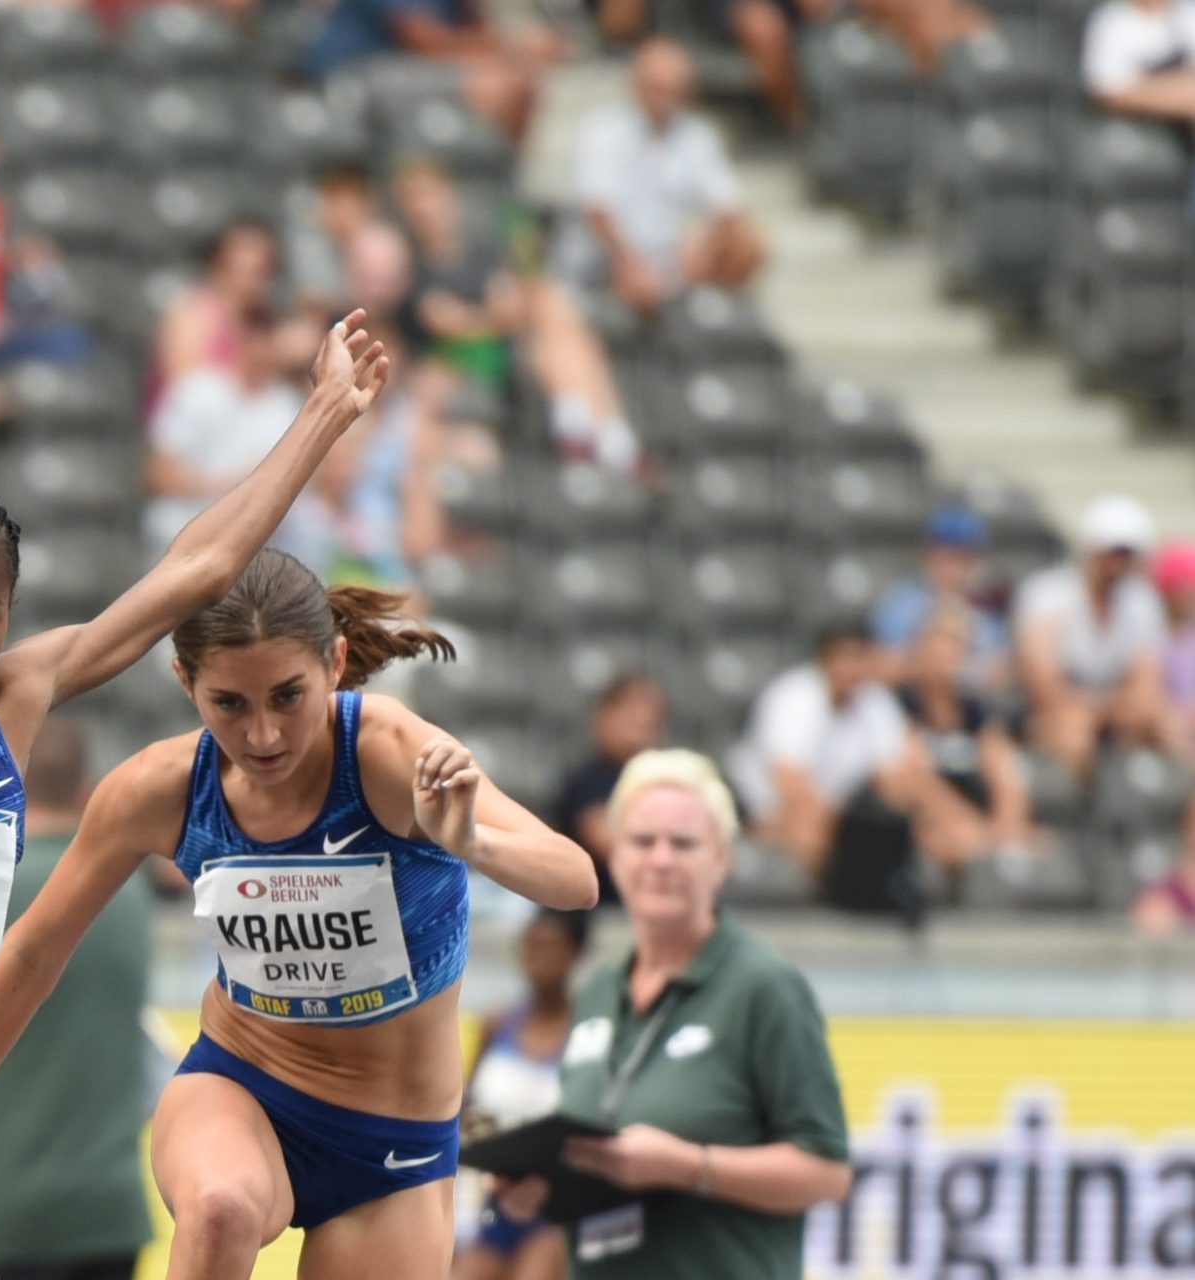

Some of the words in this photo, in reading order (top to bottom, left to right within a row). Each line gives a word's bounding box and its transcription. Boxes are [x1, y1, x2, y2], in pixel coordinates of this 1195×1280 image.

[270, 874, 343, 889] SPIELBANK
[271, 889, 319, 902] BERLIN
[216, 909, 377, 953] KRAUSE
[264, 962, 346, 981] DRIVE
[340, 990, 383, 1015] 2019
